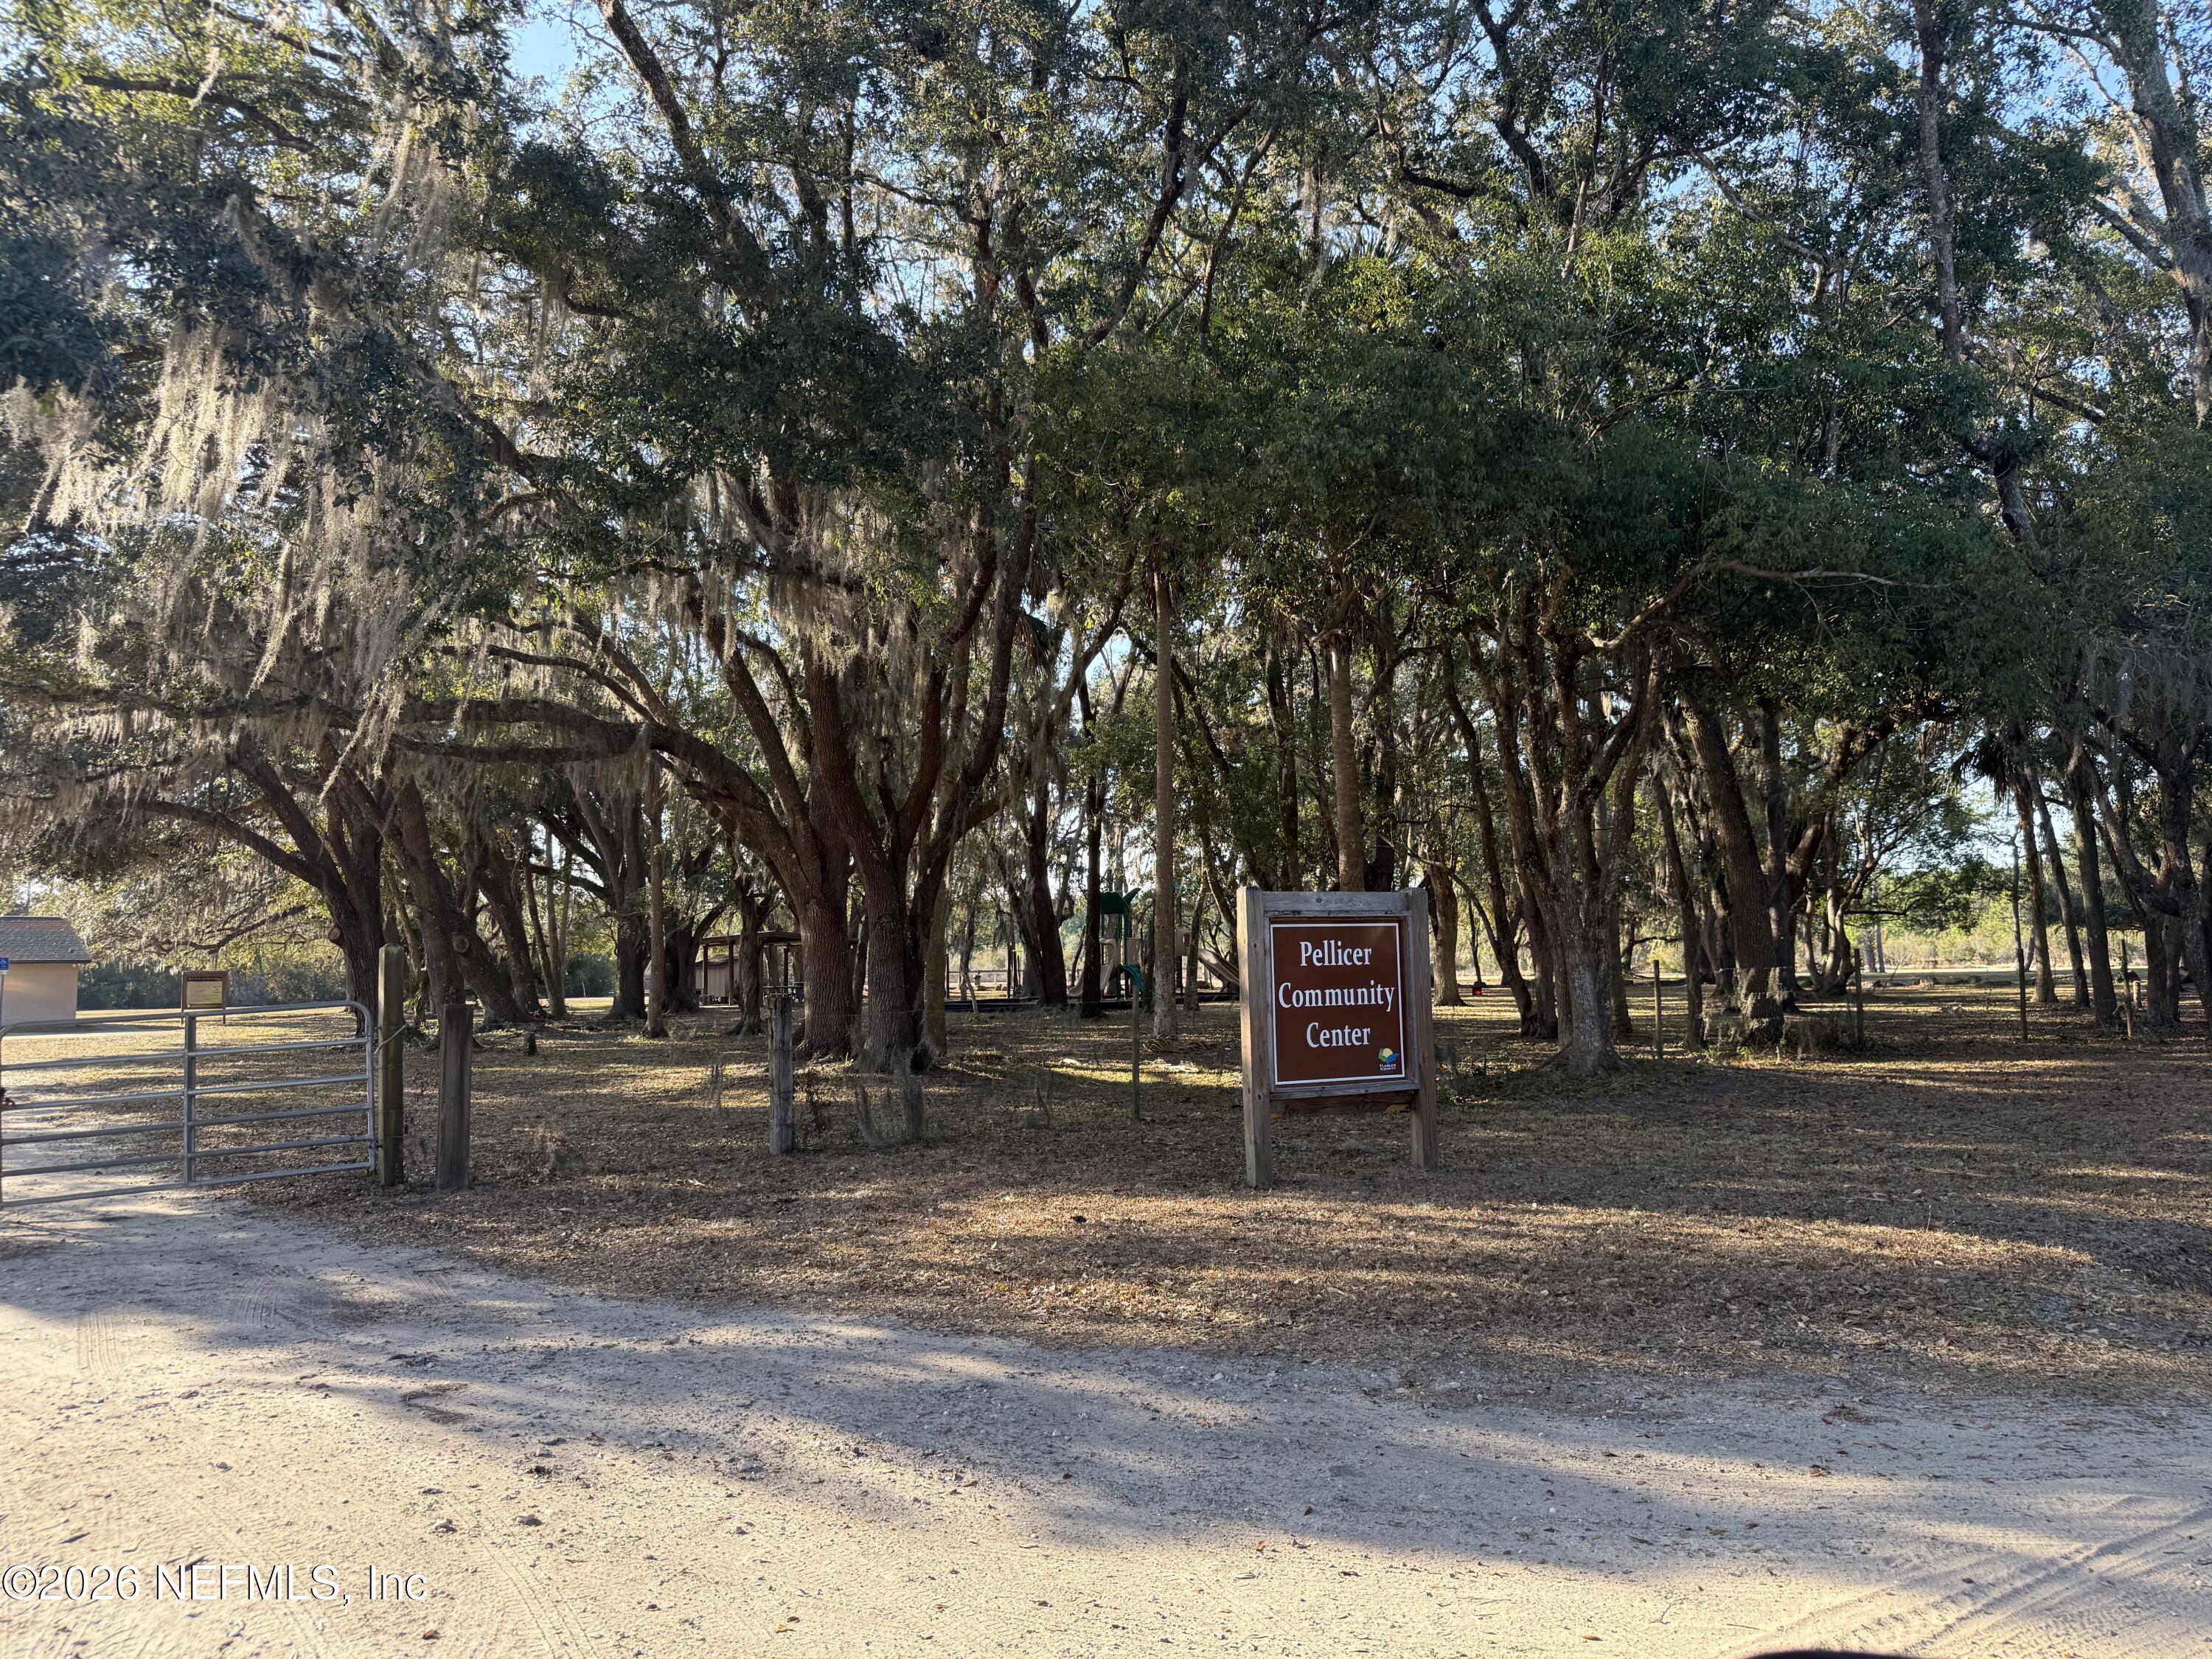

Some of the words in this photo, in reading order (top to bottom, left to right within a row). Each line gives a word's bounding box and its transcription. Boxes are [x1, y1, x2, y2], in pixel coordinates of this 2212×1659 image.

[1299, 939, 1372, 967] Pellicer
[1278, 979, 1395, 1012] Community
[1306, 1022, 1371, 1048] Center
